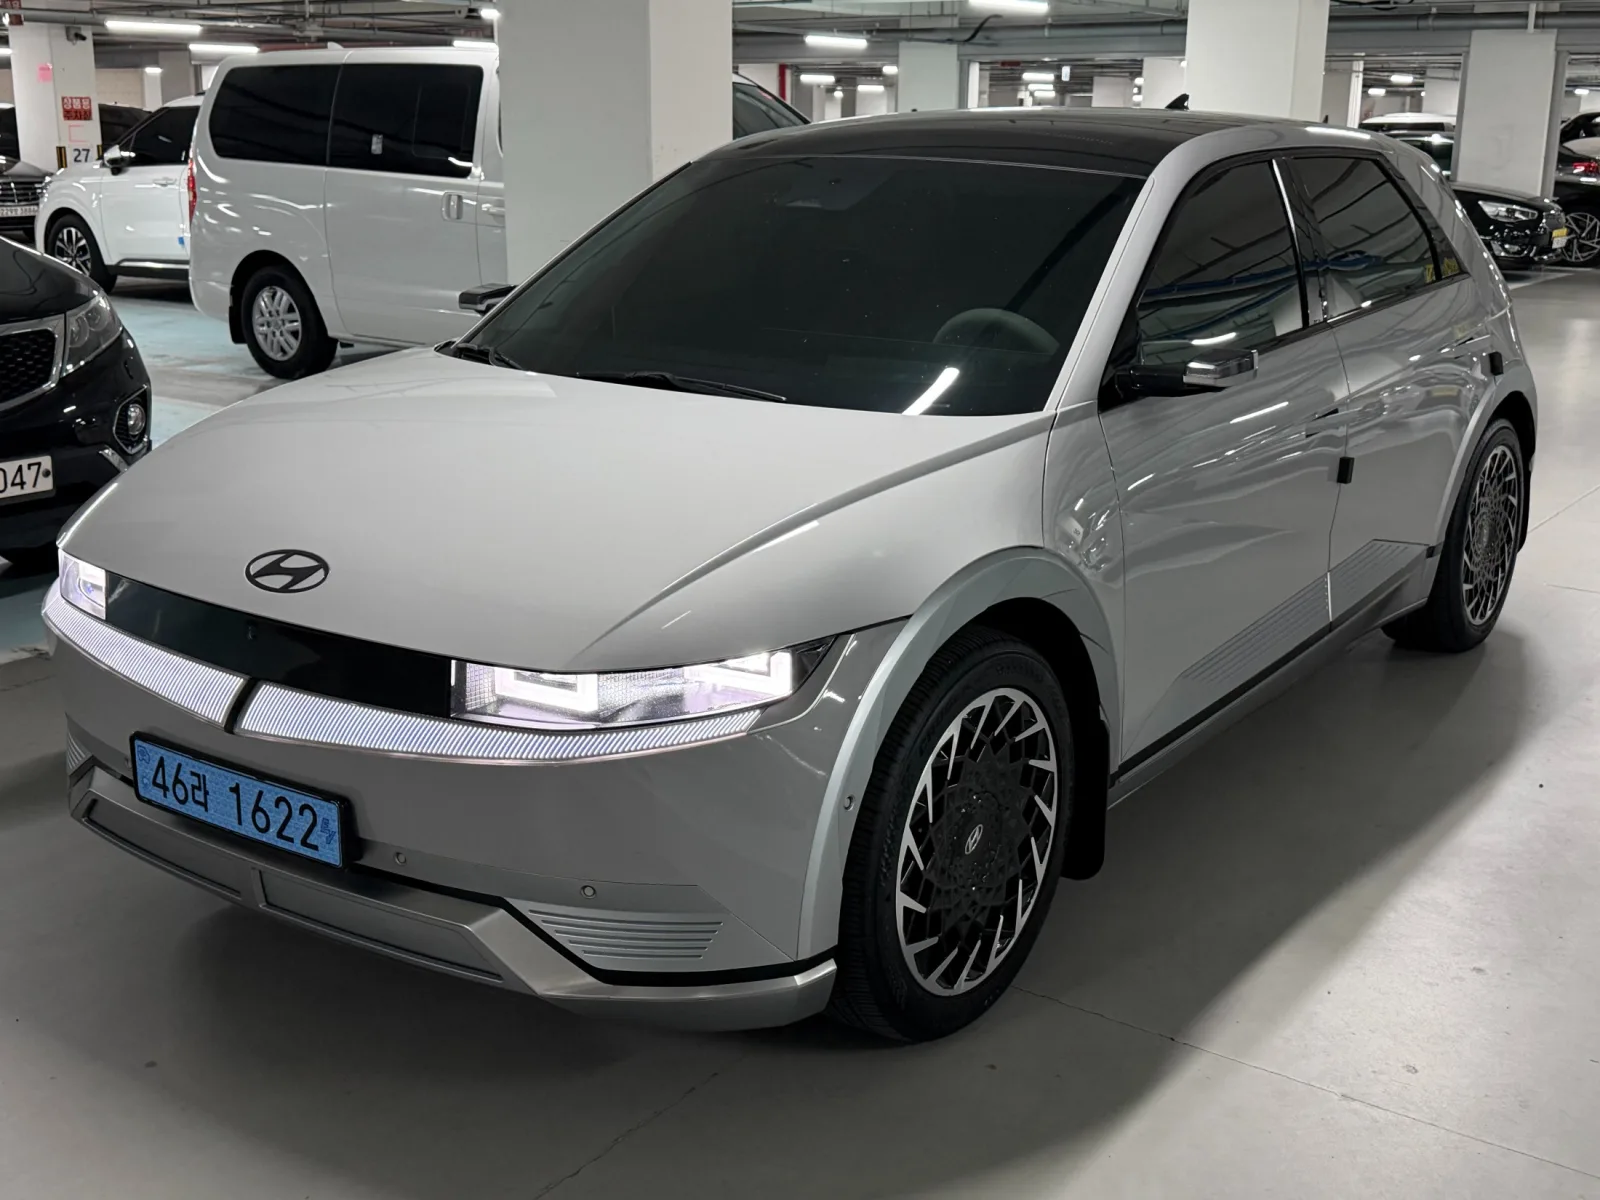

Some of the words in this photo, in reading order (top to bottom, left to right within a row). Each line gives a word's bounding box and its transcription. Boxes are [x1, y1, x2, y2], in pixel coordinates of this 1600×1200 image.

[73, 148, 91, 163] 27
[151, 756, 210, 812] 46라
[229, 782, 319, 851] 1622
